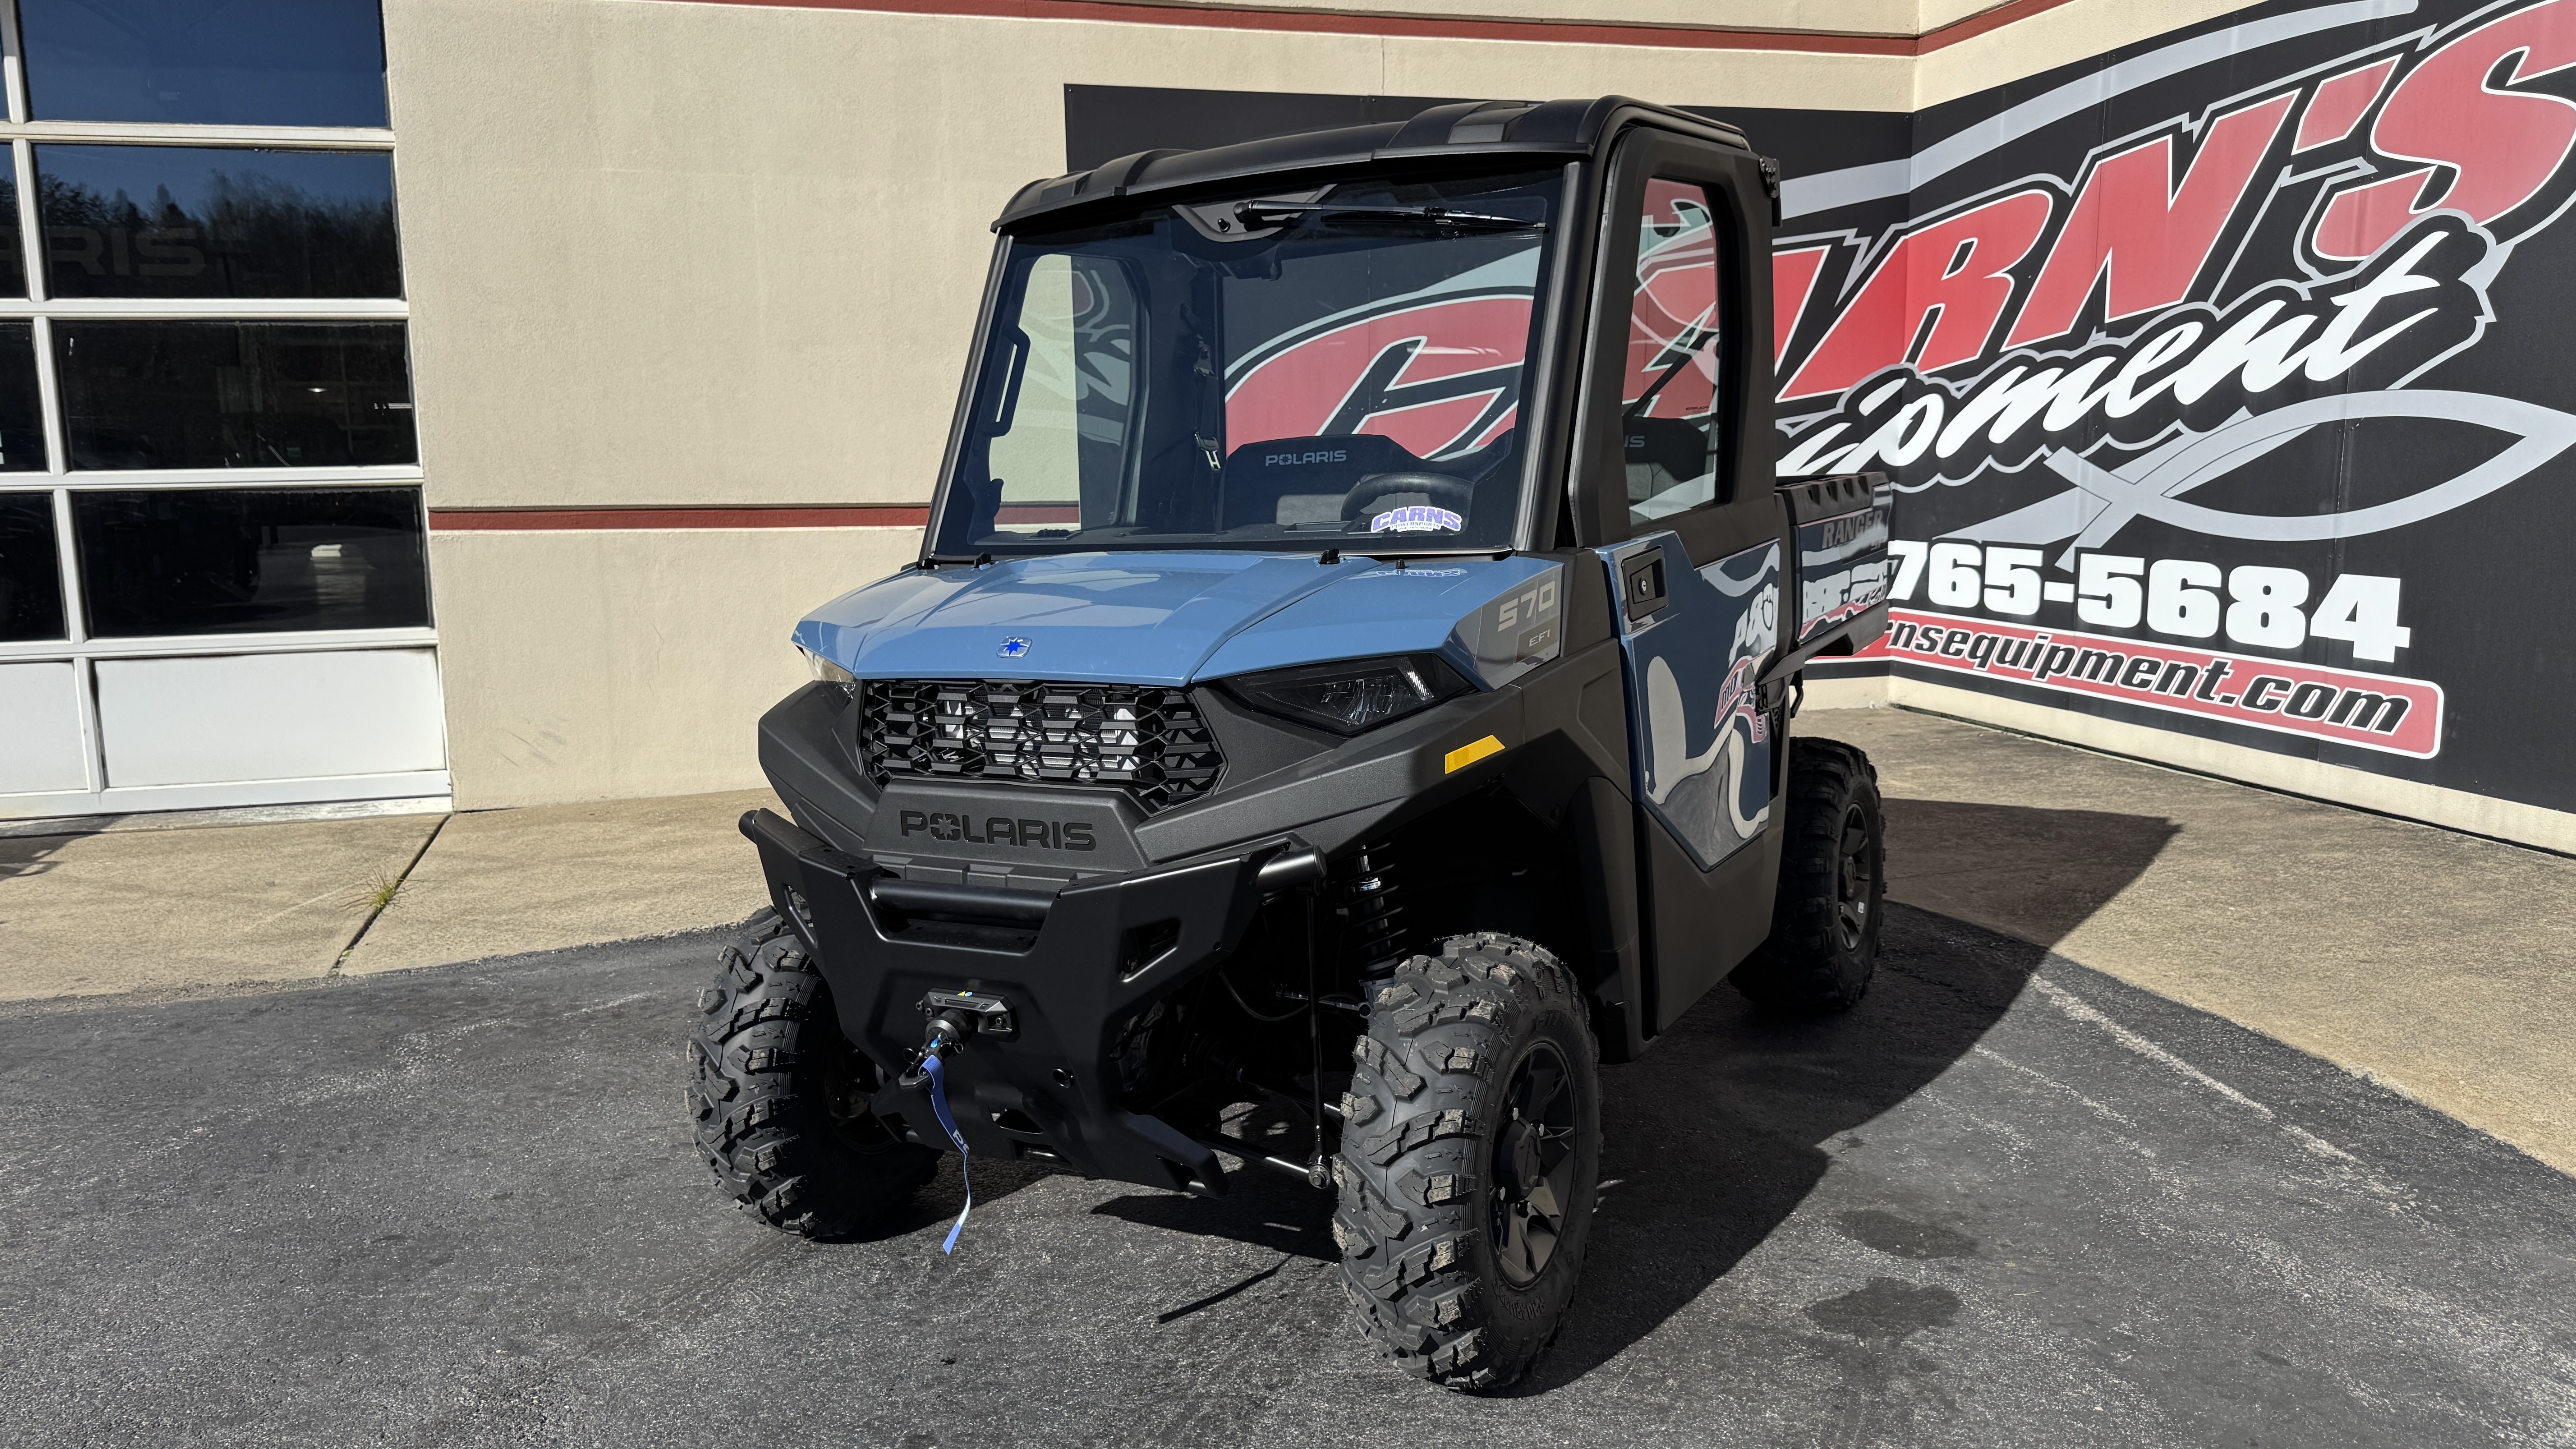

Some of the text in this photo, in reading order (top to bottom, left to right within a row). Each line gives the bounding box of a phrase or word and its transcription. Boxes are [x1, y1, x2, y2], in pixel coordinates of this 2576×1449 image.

[1265, 450, 1347, 466] POLARIS
[1373, 507, 1460, 531] CARNS
[1822, 509, 1883, 549] RANGER
[1497, 580, 1555, 632] 570
[1886, 539, 2411, 663] 765-5684
[1529, 629, 1550, 647] EFI
[1887, 621, 2410, 735] nsequipment.com
[900, 810, 1096, 852] POLARIS
